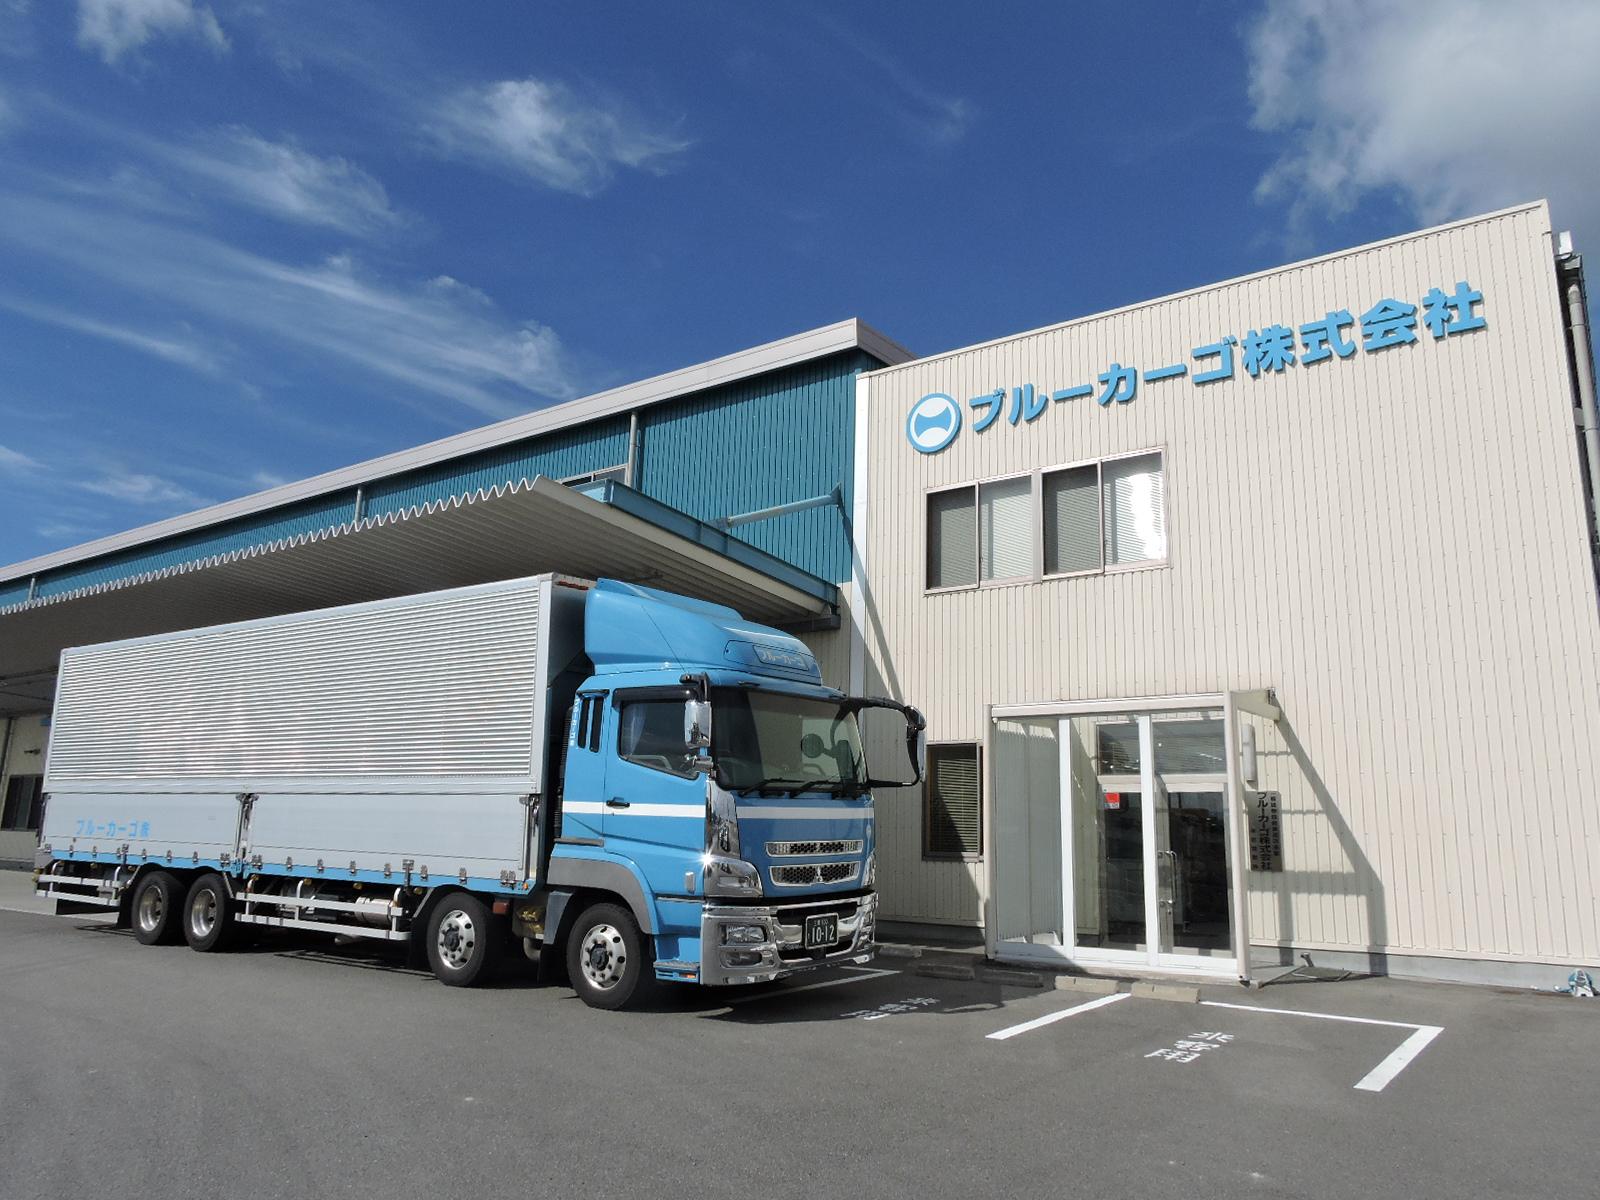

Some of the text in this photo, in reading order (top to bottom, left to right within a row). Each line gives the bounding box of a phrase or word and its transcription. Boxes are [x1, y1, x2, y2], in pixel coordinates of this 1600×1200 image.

[968, 281, 1487, 431] ブルーカーゴ株式会社
